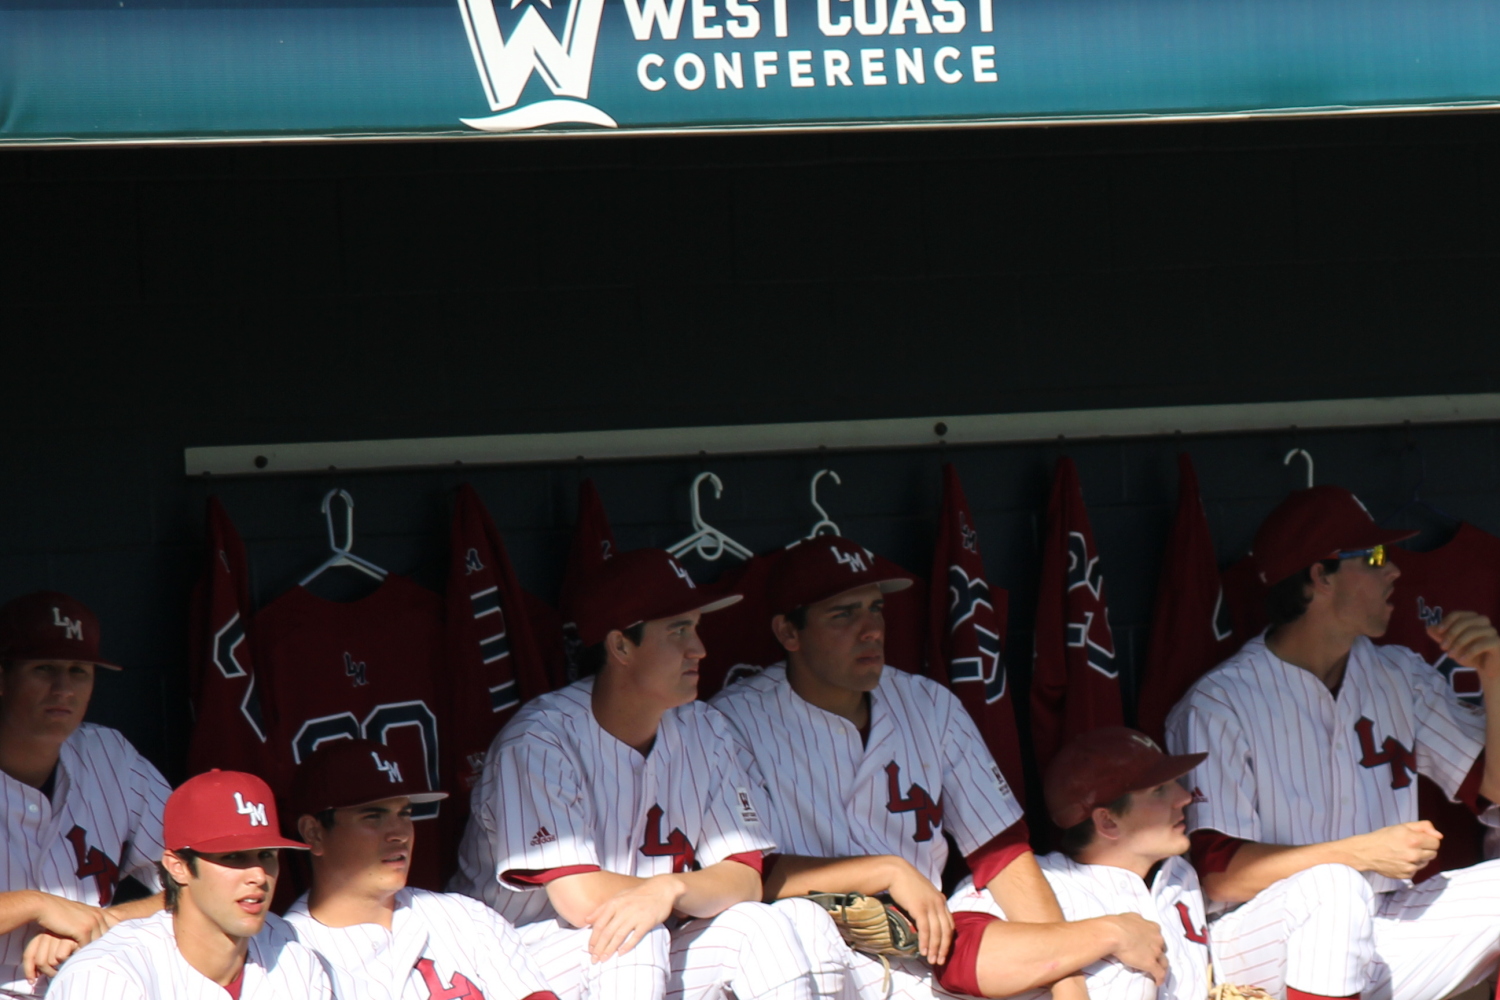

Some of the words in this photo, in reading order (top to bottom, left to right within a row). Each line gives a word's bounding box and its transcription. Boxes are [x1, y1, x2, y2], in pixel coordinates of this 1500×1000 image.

[636, 45, 998, 92] CONFERENCE
[830, 545, 868, 573] LM
[52, 606, 84, 641] LM
[343, 651, 369, 688] LM
[371, 750, 404, 784] LM
[233, 791, 269, 827] LM
[1175, 900, 1209, 945] L
